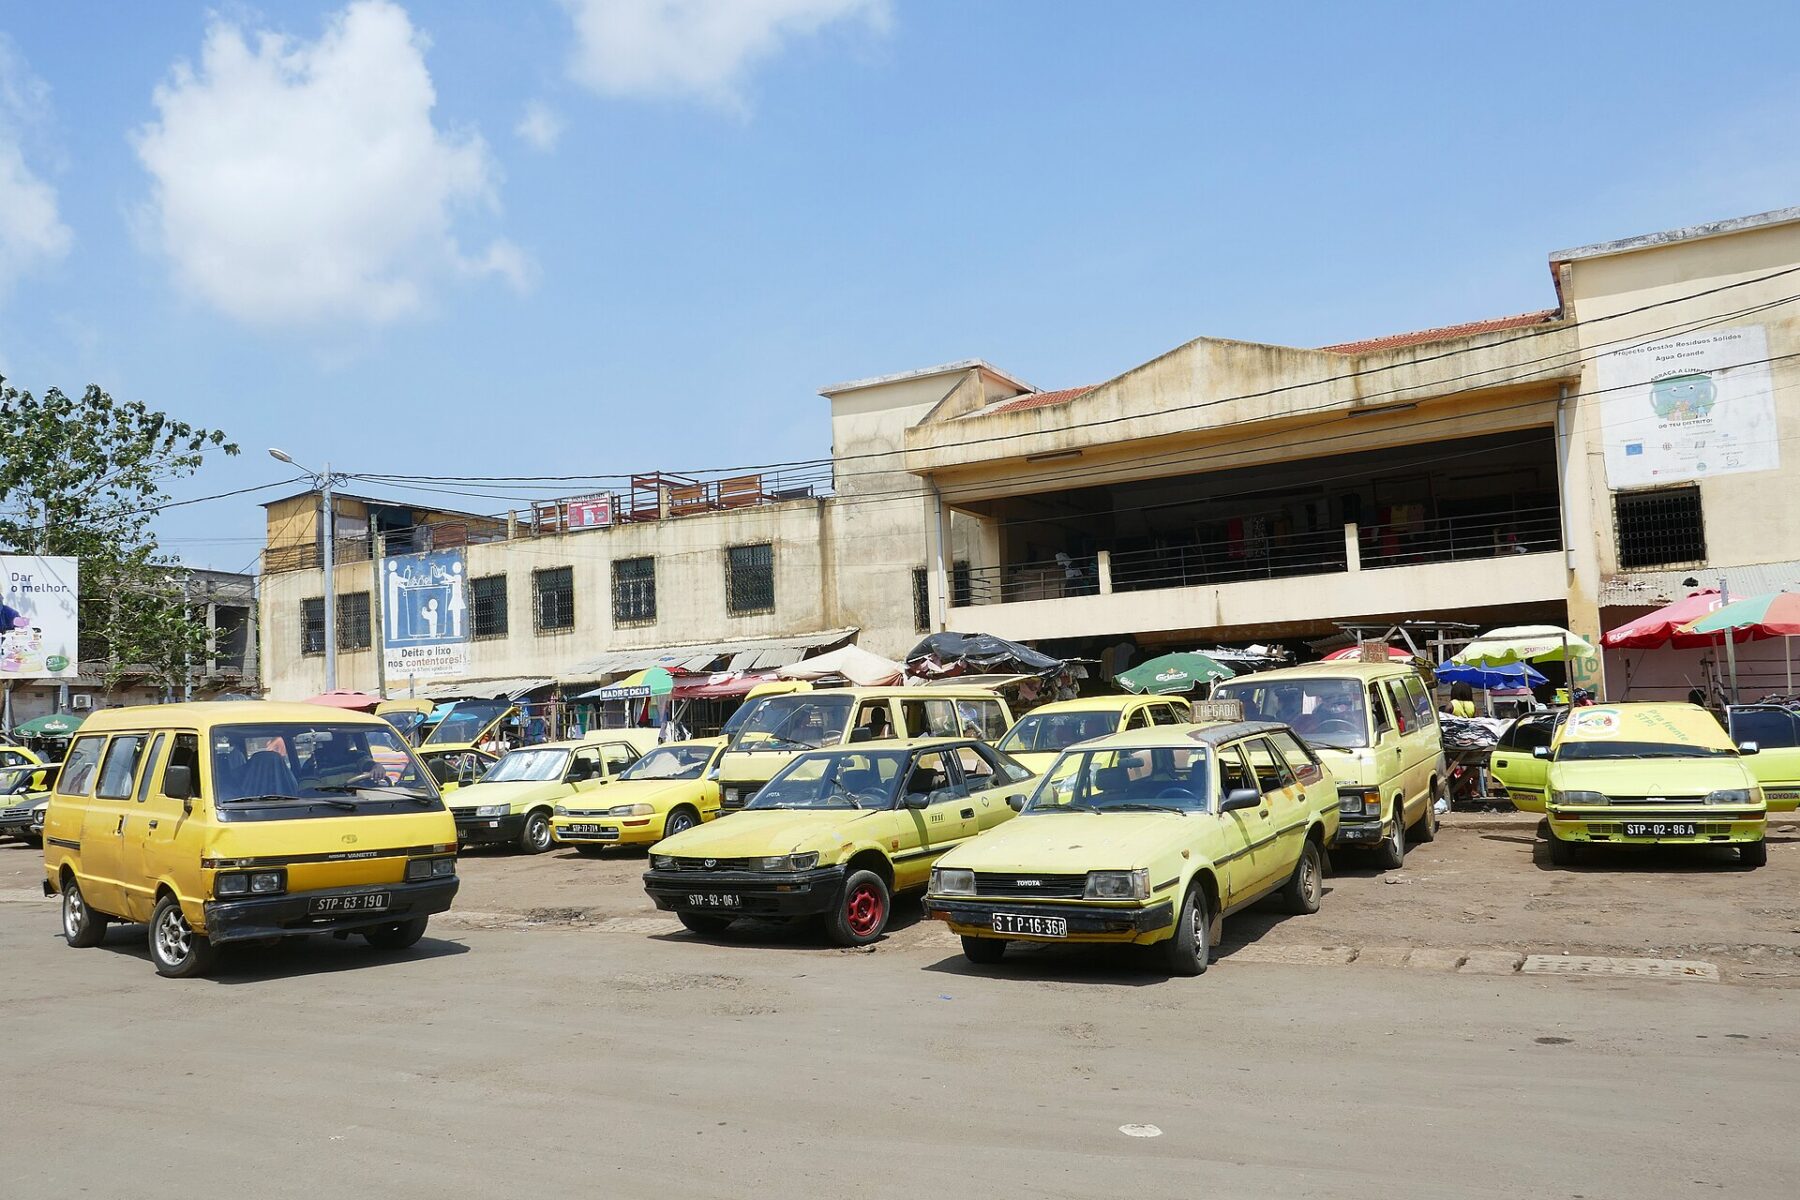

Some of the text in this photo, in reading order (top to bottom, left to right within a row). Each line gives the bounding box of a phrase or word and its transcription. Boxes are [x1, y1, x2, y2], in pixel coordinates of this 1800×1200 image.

[1676, 350, 1705, 358] Grande
[11, 572, 34, 582] Dar
[10, 583, 70, 593] o melhor.
[401, 647, 425, 658] Deita
[435, 645, 452, 655] lixo
[388, 653, 462, 668] nos contentores!
[601, 686, 650, 699] MADRE DEUS
[1766, 792, 1800, 800] TOYOTA
